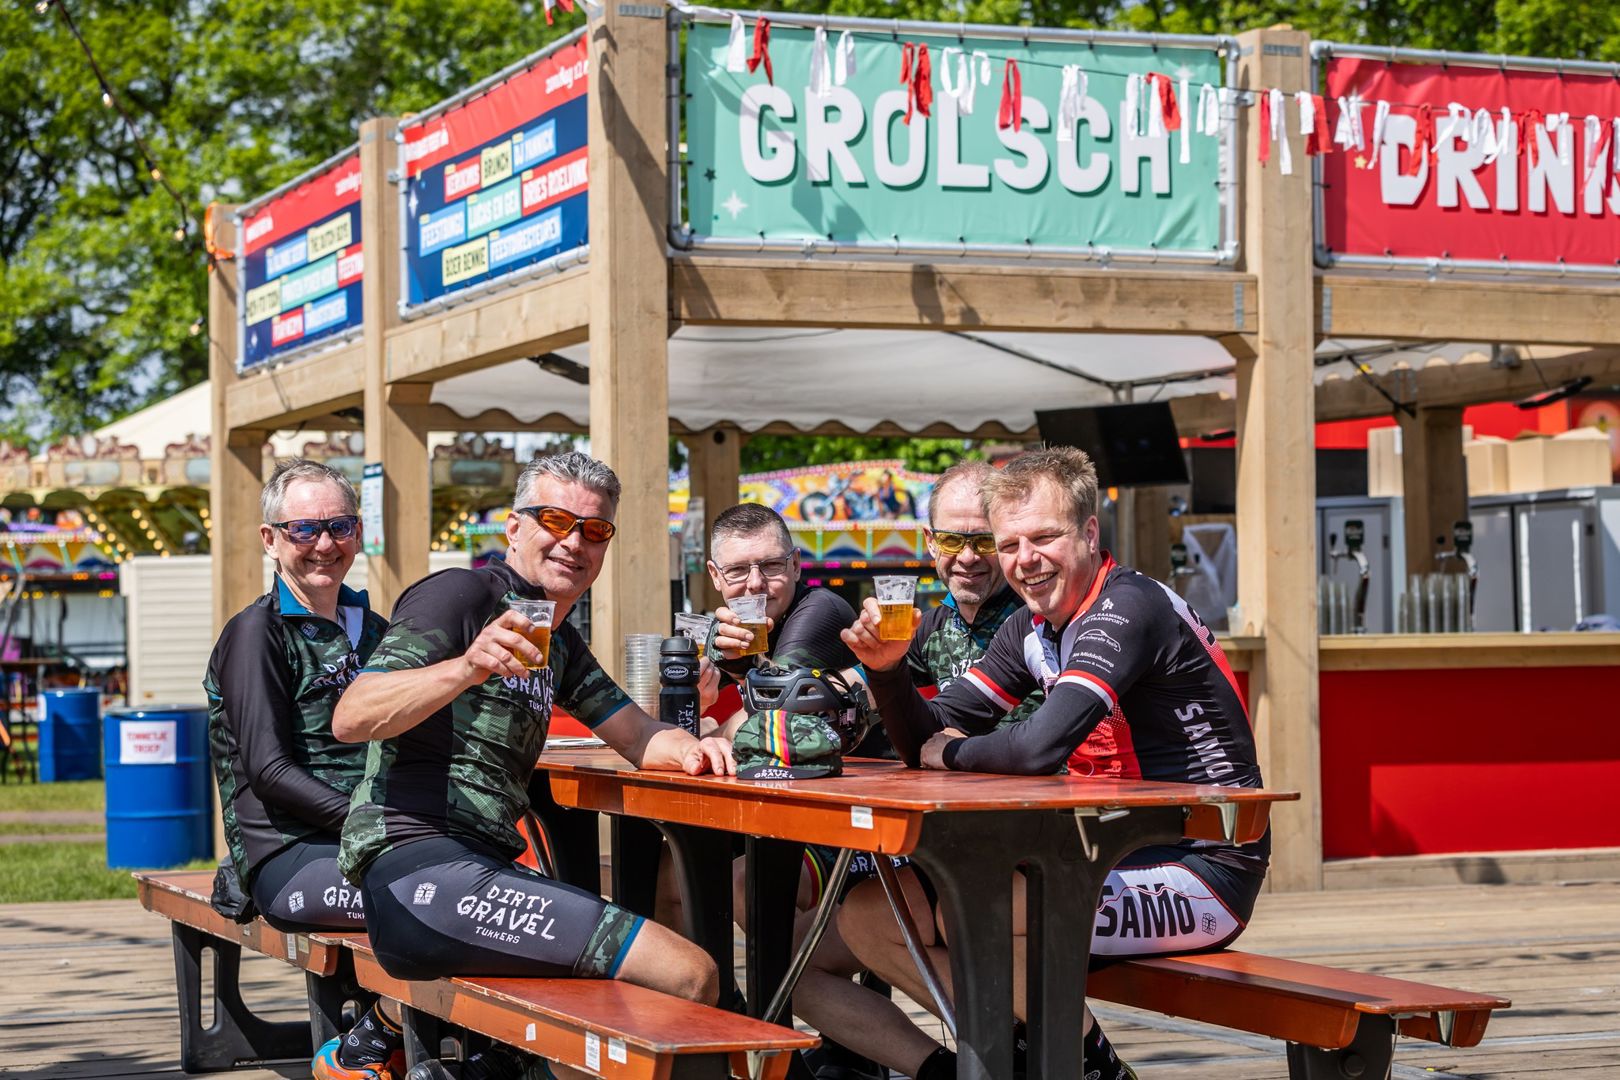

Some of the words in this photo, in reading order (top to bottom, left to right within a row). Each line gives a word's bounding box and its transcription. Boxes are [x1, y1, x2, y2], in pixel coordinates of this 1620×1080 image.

[739, 85, 1171, 195] GROLSCH
[1174, 703, 1239, 785] SAMO
[323, 886, 364, 909] GRA
[457, 895, 555, 940] GRAVEL
[486, 885, 553, 914] DIRTY
[1095, 882, 1196, 938] SAMO
[475, 926, 520, 944] TUKKERS
